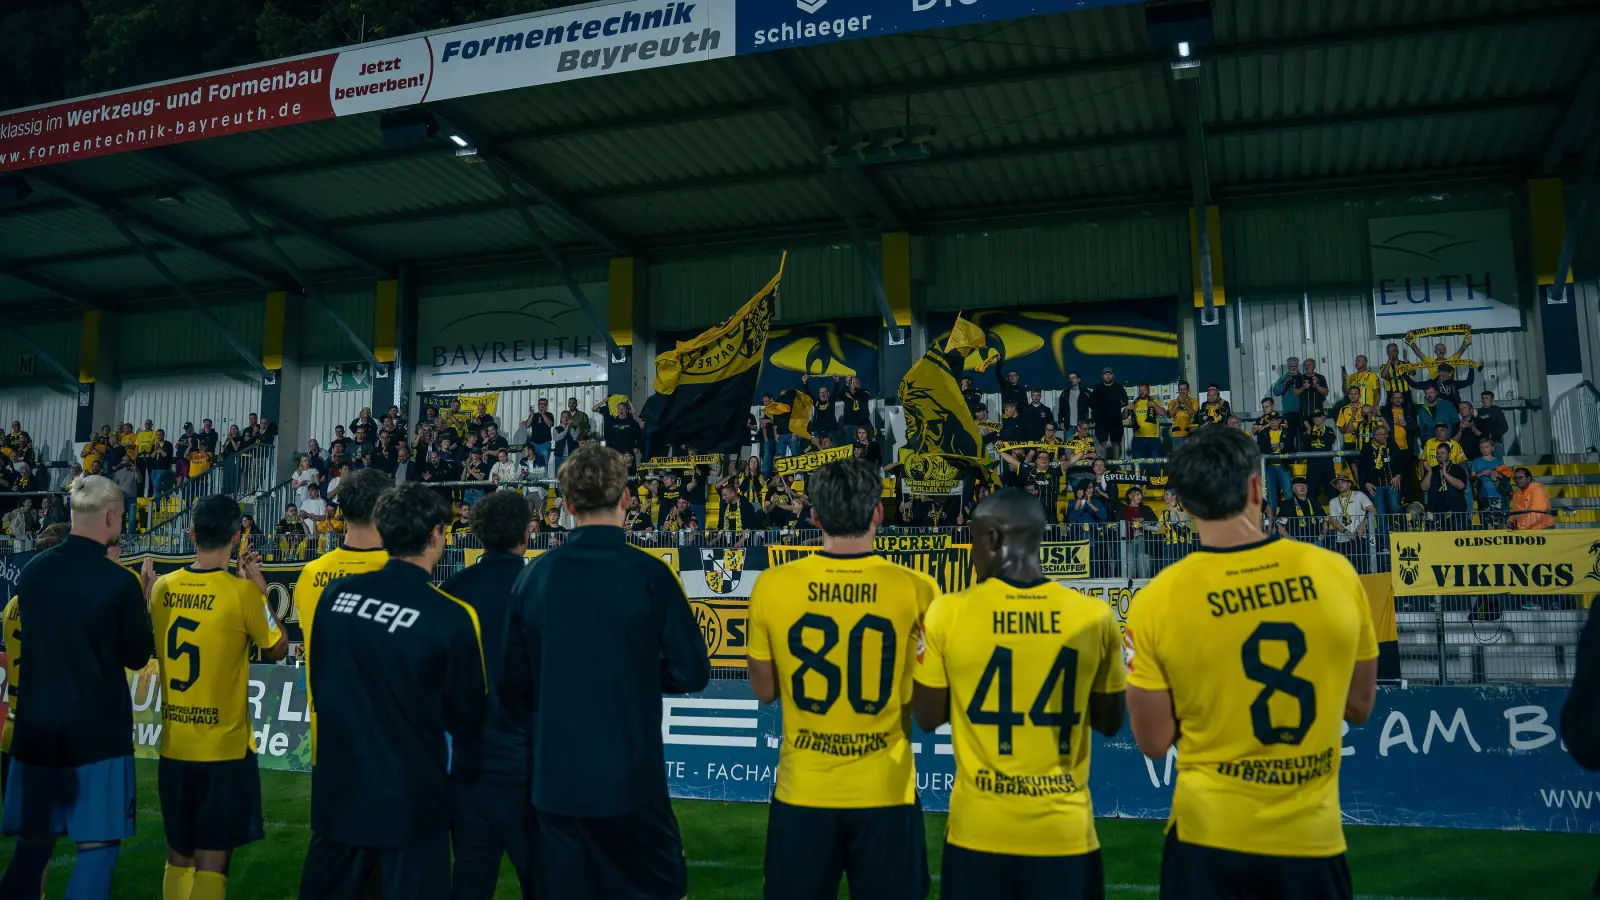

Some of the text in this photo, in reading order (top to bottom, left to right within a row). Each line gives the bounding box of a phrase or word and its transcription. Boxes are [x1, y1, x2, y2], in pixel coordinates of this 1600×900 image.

[441, 2, 697, 63] Formentechnik
[754, 14, 872, 45] schlaeger
[556, 27, 722, 73] Bayreuth
[359, 57, 402, 76] Jetzt
[335, 73, 425, 101] bewerben!
[46, 114, 63, 132] im
[67, 98, 161, 128] Werkzeug-
[166, 87, 202, 109] und
[208, 67, 323, 102] Formenbau
[1380, 272, 1493, 306] EUTH
[432, 335, 592, 373] BAYREUTH
[873, 535, 947, 551] UPCREW
[1454, 535, 1546, 547] OLDSCHDOD
[1431, 563, 1574, 587] VIKINGS
[163, 592, 216, 611] SCHWARZ
[808, 582, 877, 604] SHAQIRI
[1207, 575, 1318, 618] SCHEDER
[356, 597, 421, 634] cep
[993, 611, 1062, 634] HEINLE
[167, 615, 201, 692] 5
[788, 612, 897, 715] 80
[1242, 622, 1316, 745] 8
[167, 705, 219, 716] BAYREUTHER
[966, 645, 1081, 754] 44
[167, 713, 219, 725] BRAUHAUS
[812, 730, 890, 744] BAYREUTHER
[1380, 708, 1481, 756] AM
[811, 739, 887, 757] BRAUHAUS
[1240, 747, 1334, 771] BAYREUTHER
[995, 770, 1074, 786] BAYREUTHER
[1242, 762, 1333, 785] BRAUHAUS
[995, 783, 1078, 797] BRAUHAUS
[1540, 788, 1600, 810] ww
